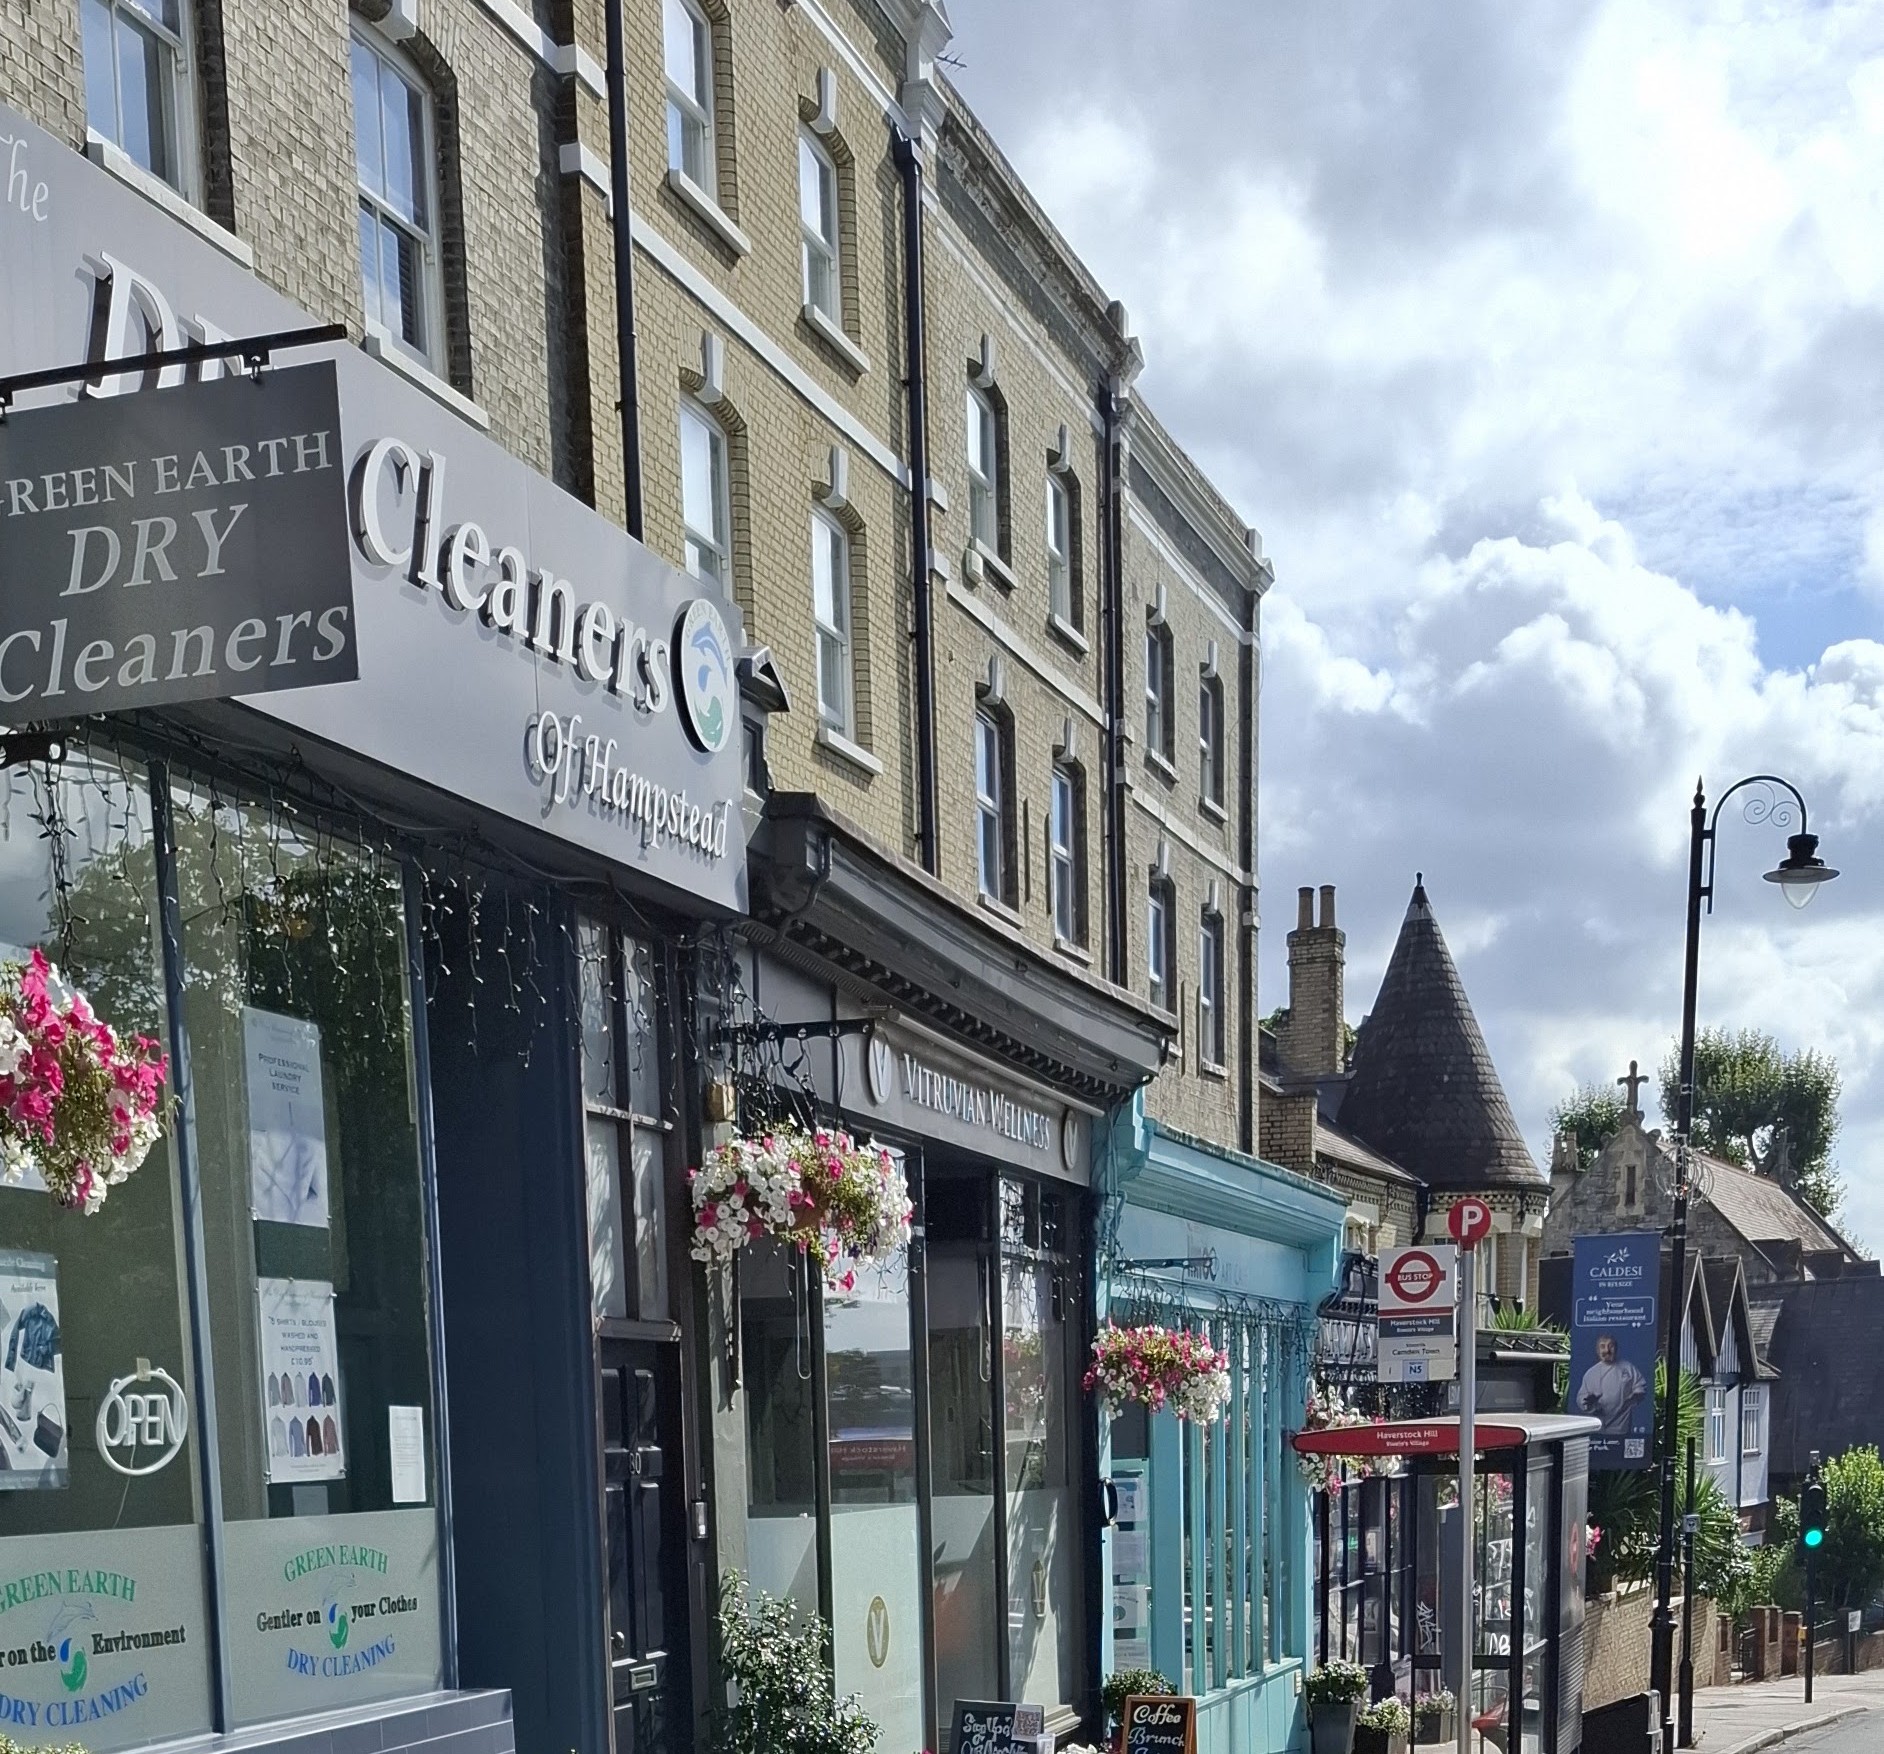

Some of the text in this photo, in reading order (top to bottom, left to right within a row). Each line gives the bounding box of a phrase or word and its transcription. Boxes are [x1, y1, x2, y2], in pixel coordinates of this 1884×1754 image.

[0, 134, 49, 221] he
[0, 431, 333, 516] REEN EARTH
[60, 504, 248, 598] DRY
[363, 437, 671, 713] Cleaners
[0, 605, 348, 703] Cleaners
[537, 711, 732, 858] Of Hampstead
[904, 1053, 986, 1127] VITRUVIAN
[1462, 1205, 1483, 1237] P
[1397, 1272, 1433, 1282] BUS STOP
[1590, 1266, 1643, 1277] CALDESI
[1409, 1366, 1422, 1374] N5
[100, 1393, 182, 1446] OPEN
[1376, 1430, 1438, 1439] Haverstock Hill
[284, 1545, 388, 1582] GREEN EARTH
[67, 1569, 137, 1602] EARTH
[256, 1594, 418, 1632] Gentler on your Clothes
[8, 1648, 28, 1666] on
[31, 1641, 56, 1662] the
[91, 1624, 186, 1655] Environment
[287, 1633, 395, 1677] DRY CLEANING
[0, 1672, 149, 1727] DRY CLEANING
[1133, 1703, 1181, 1724] Coffee
[1127, 1726, 1185, 1747] Brunch
